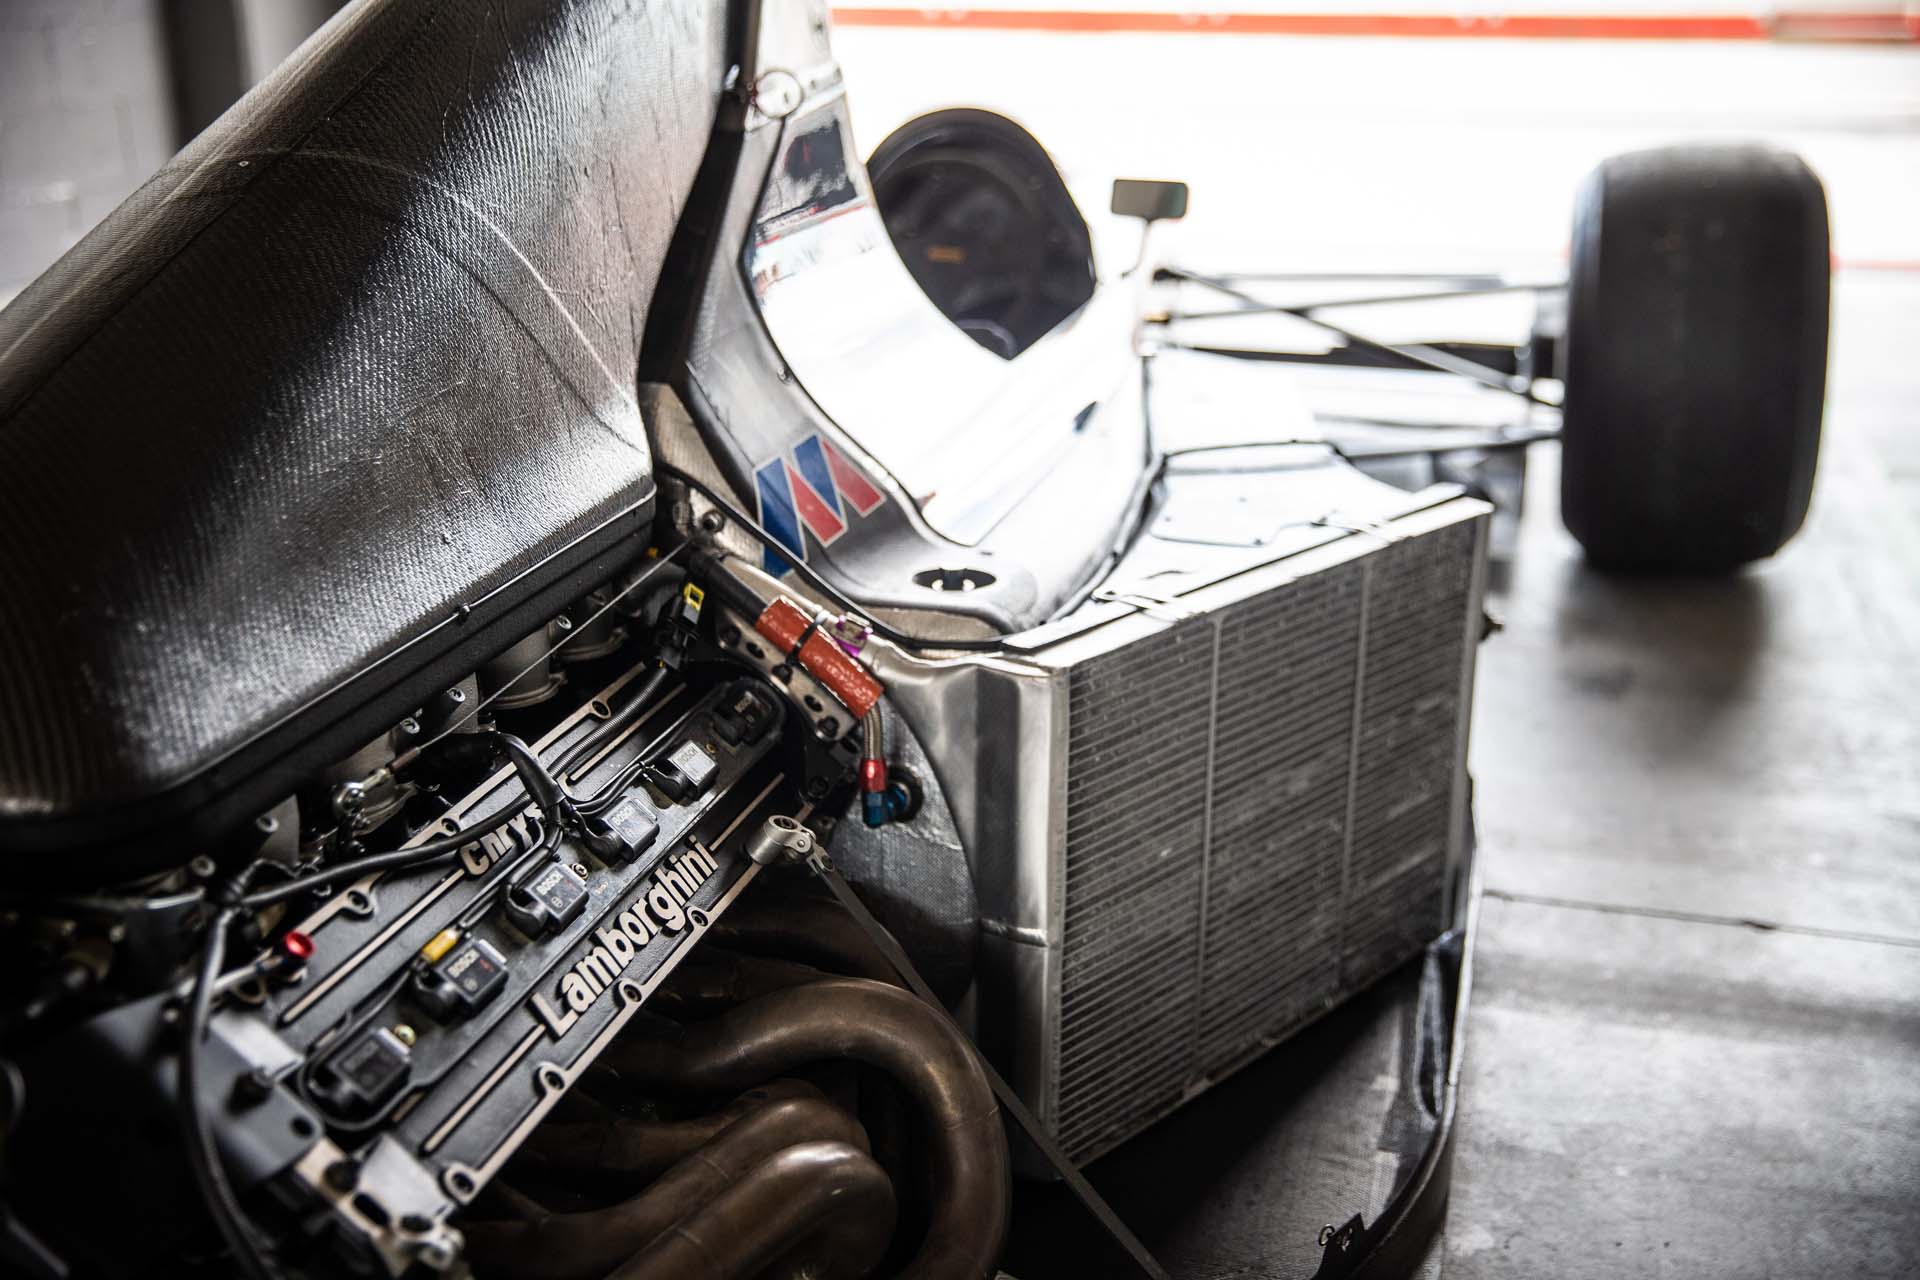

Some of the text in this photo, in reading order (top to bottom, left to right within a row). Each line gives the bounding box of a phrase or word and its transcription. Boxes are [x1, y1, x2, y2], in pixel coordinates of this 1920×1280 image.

[610, 803, 637, 826] BOSCH
[535, 869, 565, 896] BOSCH
[531, 834, 719, 1037] Lamborghini
[447, 947, 481, 979] BOSCH
